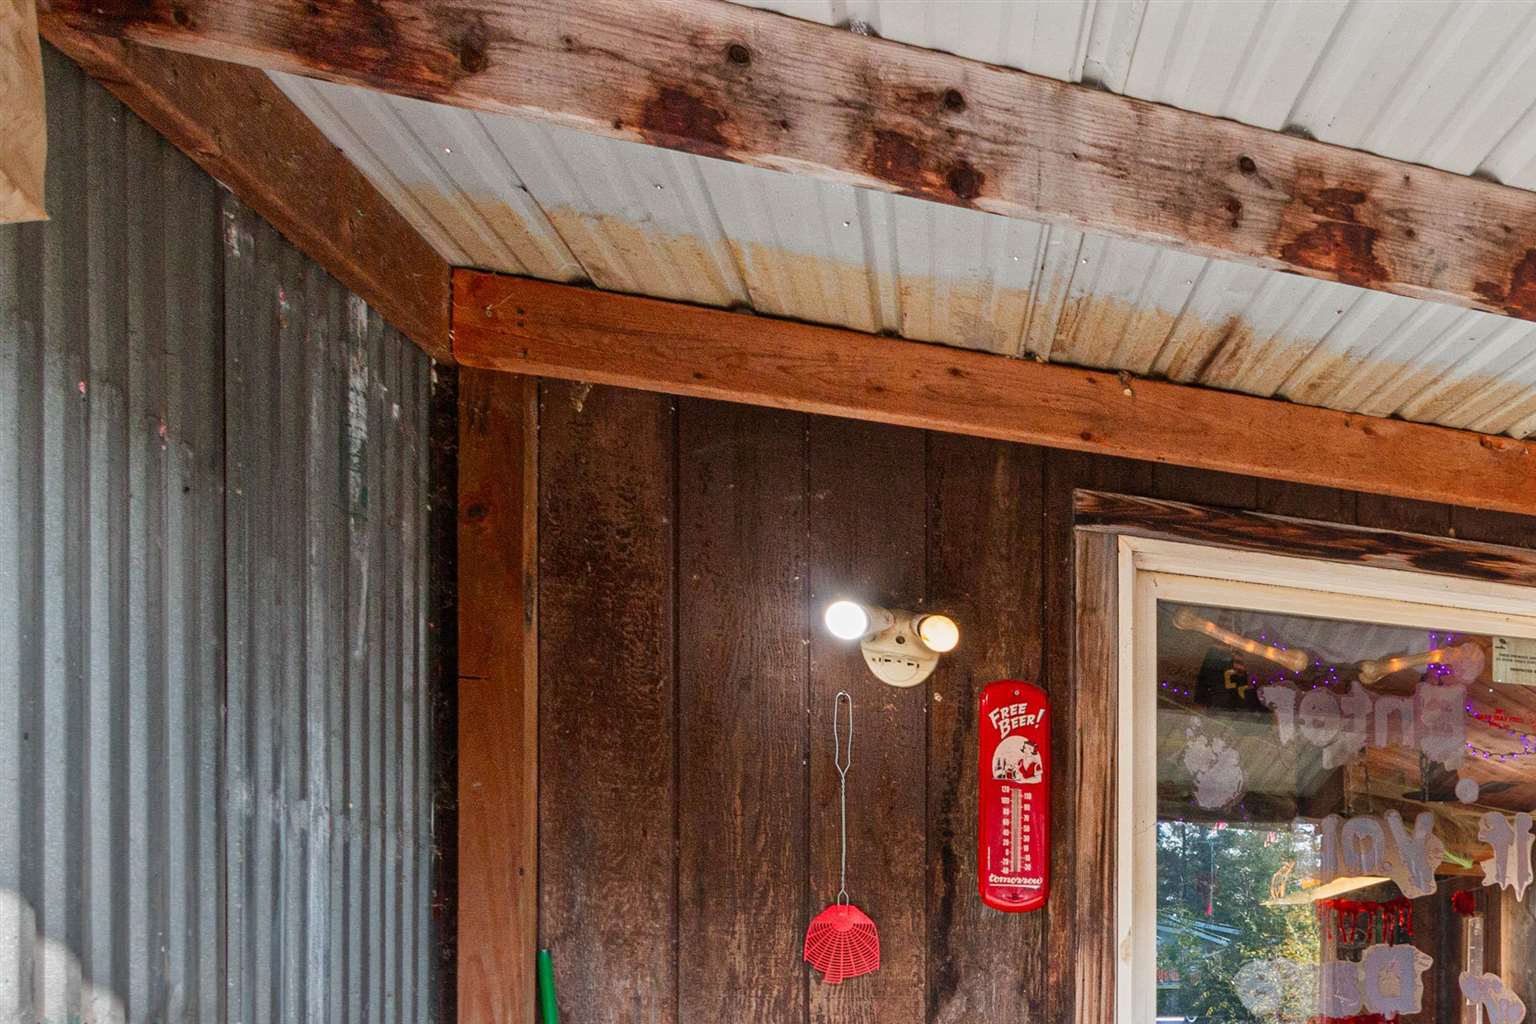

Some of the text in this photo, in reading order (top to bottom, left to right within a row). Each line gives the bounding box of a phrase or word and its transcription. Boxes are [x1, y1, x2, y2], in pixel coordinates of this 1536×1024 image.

[988, 703, 1028, 729] FREE
[998, 709, 1046, 739] BEER!
[989, 873, 1043, 884] tomorrow
